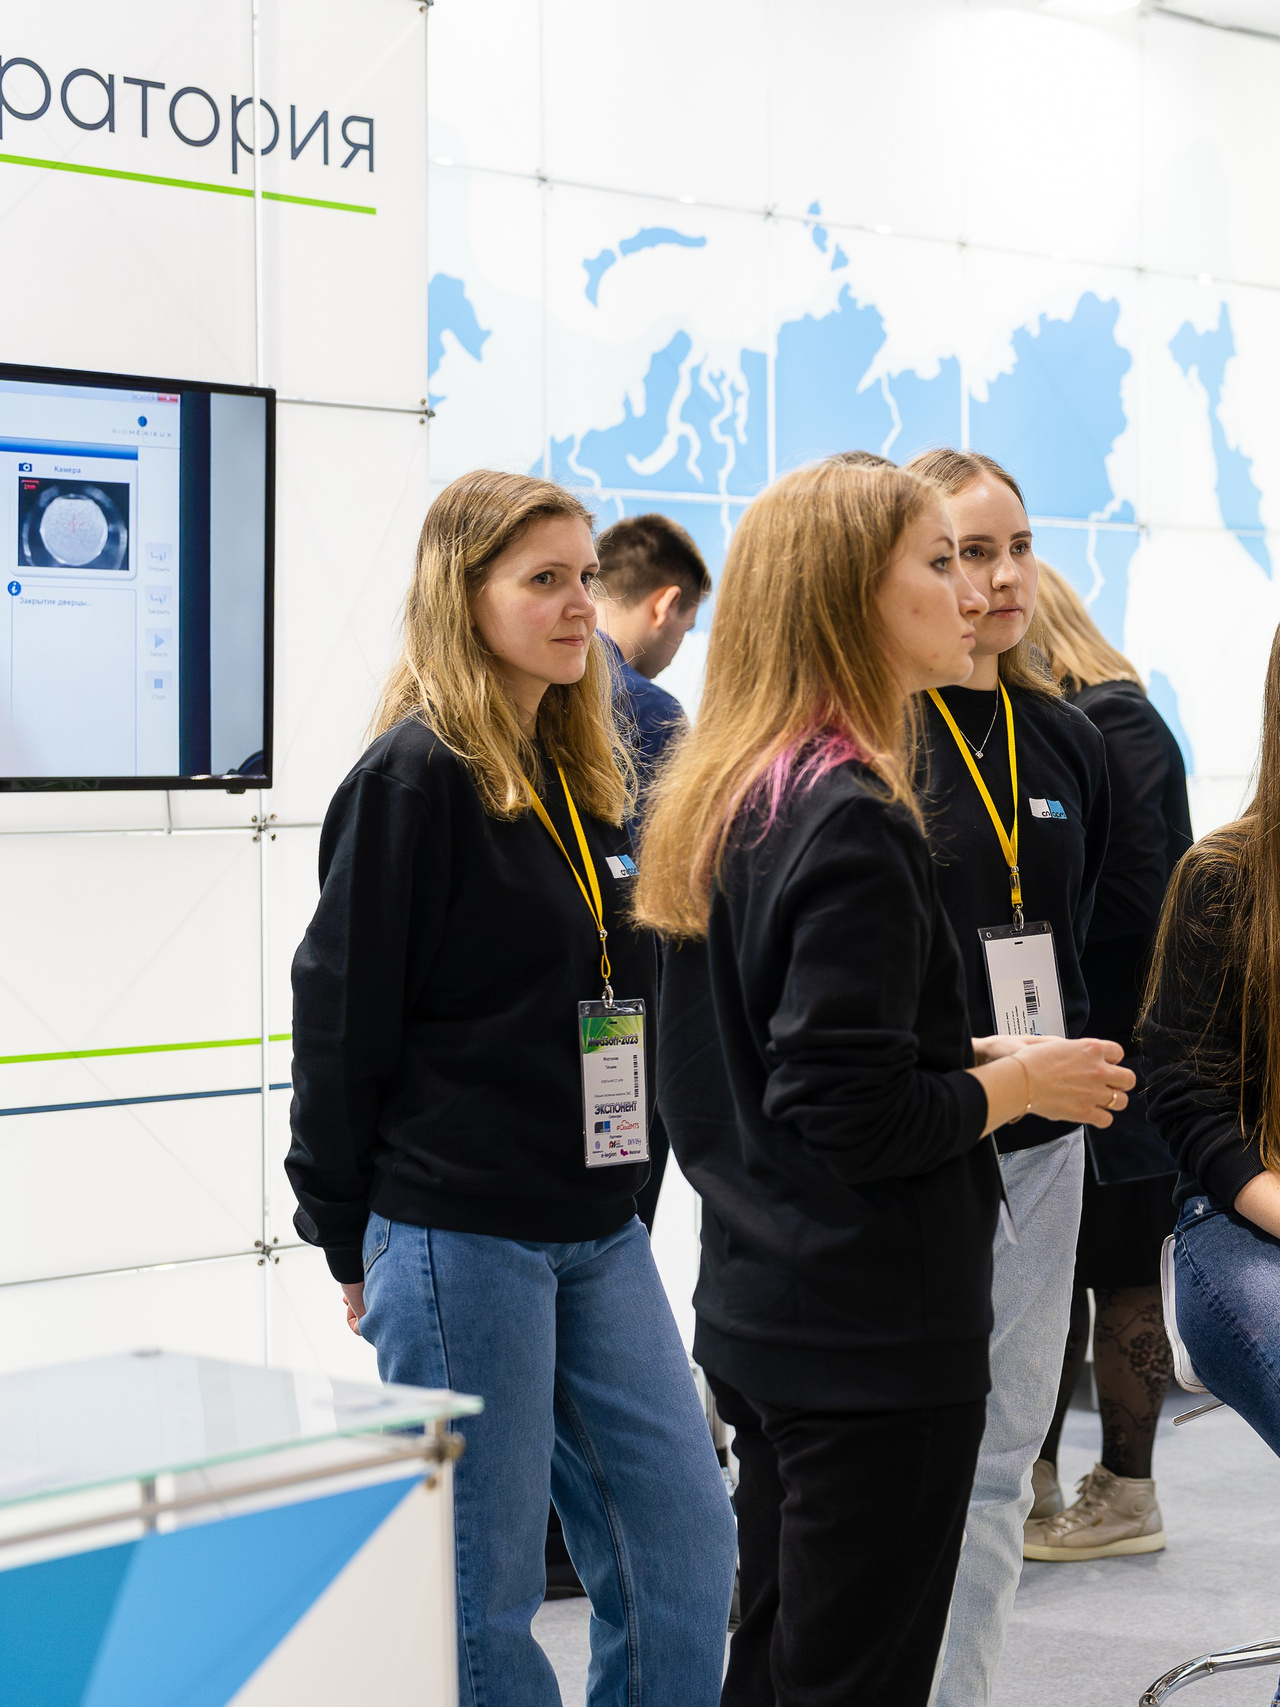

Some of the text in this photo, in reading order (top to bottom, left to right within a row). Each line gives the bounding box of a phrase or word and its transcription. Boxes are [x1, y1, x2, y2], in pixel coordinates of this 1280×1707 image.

[0, 54, 375, 174] ратория
[54, 465, 82, 474] Камера
[594, 1101, 637, 1115] ЭКСПОНЕНТ
